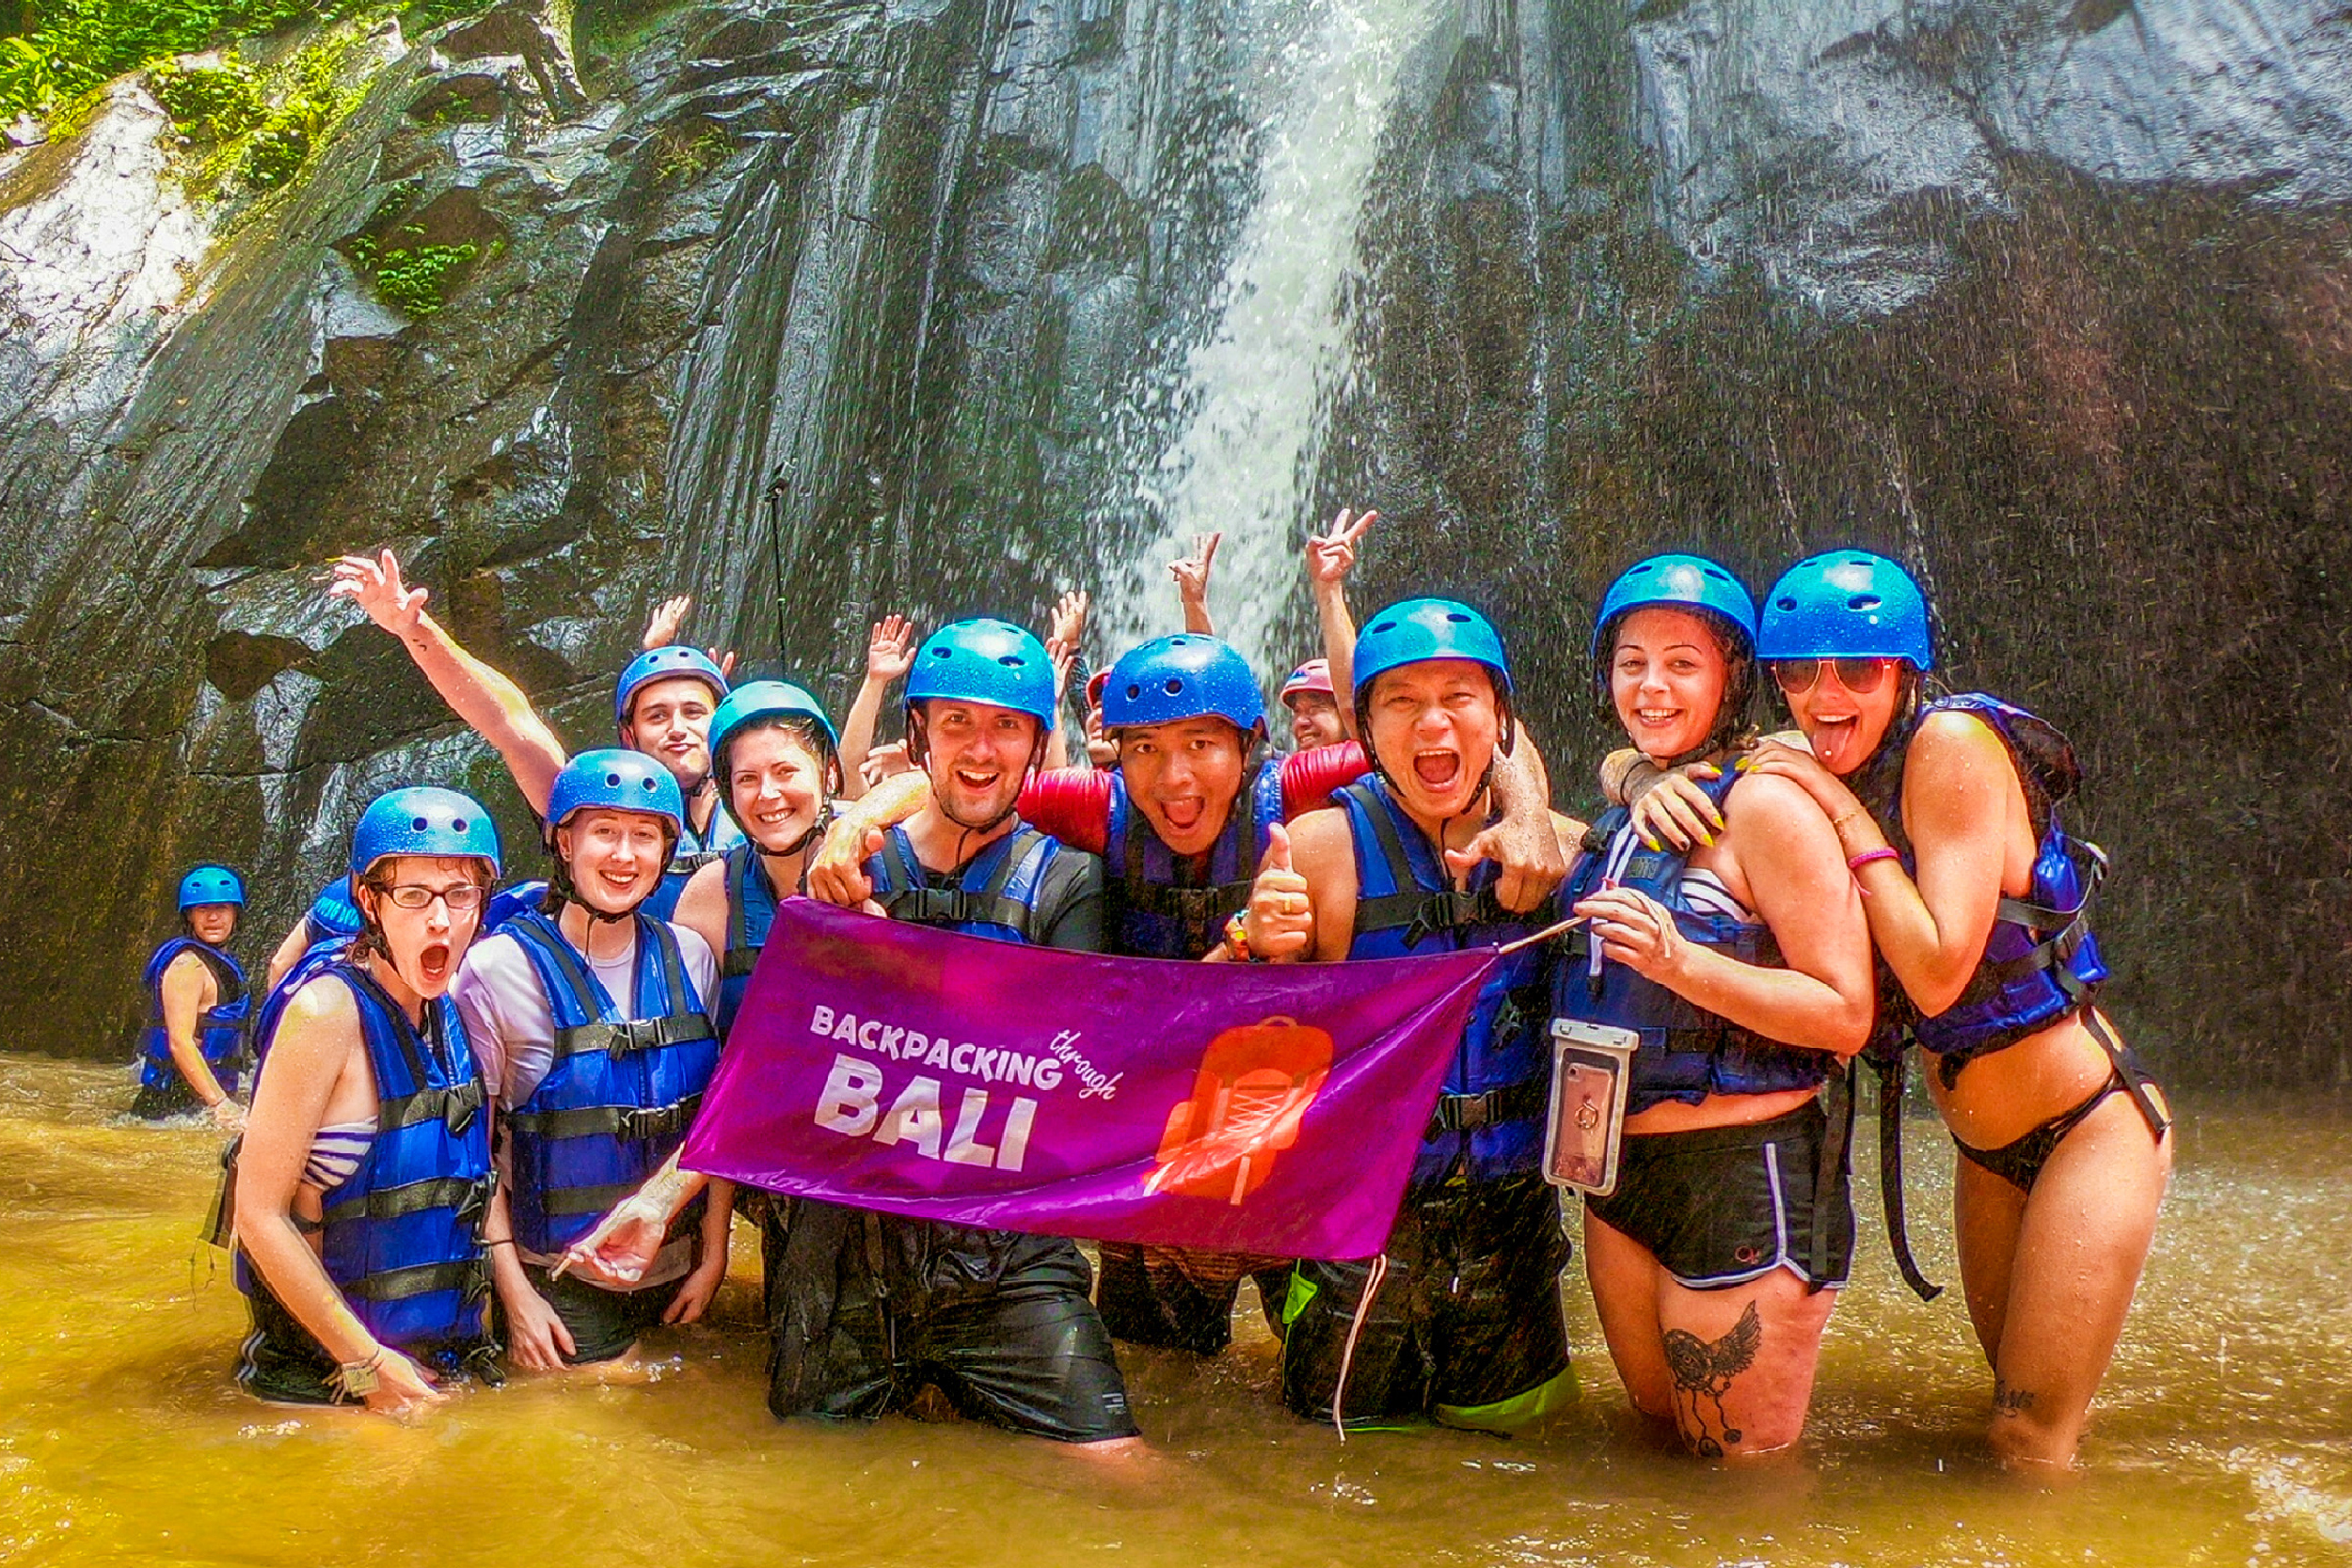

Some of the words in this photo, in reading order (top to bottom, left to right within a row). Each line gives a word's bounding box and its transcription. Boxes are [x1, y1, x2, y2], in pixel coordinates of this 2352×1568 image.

[810, 1005, 1063, 1090] BACKPACKING
[1049, 1029, 1124, 1100] through
[814, 1053, 1038, 1172] BALI
